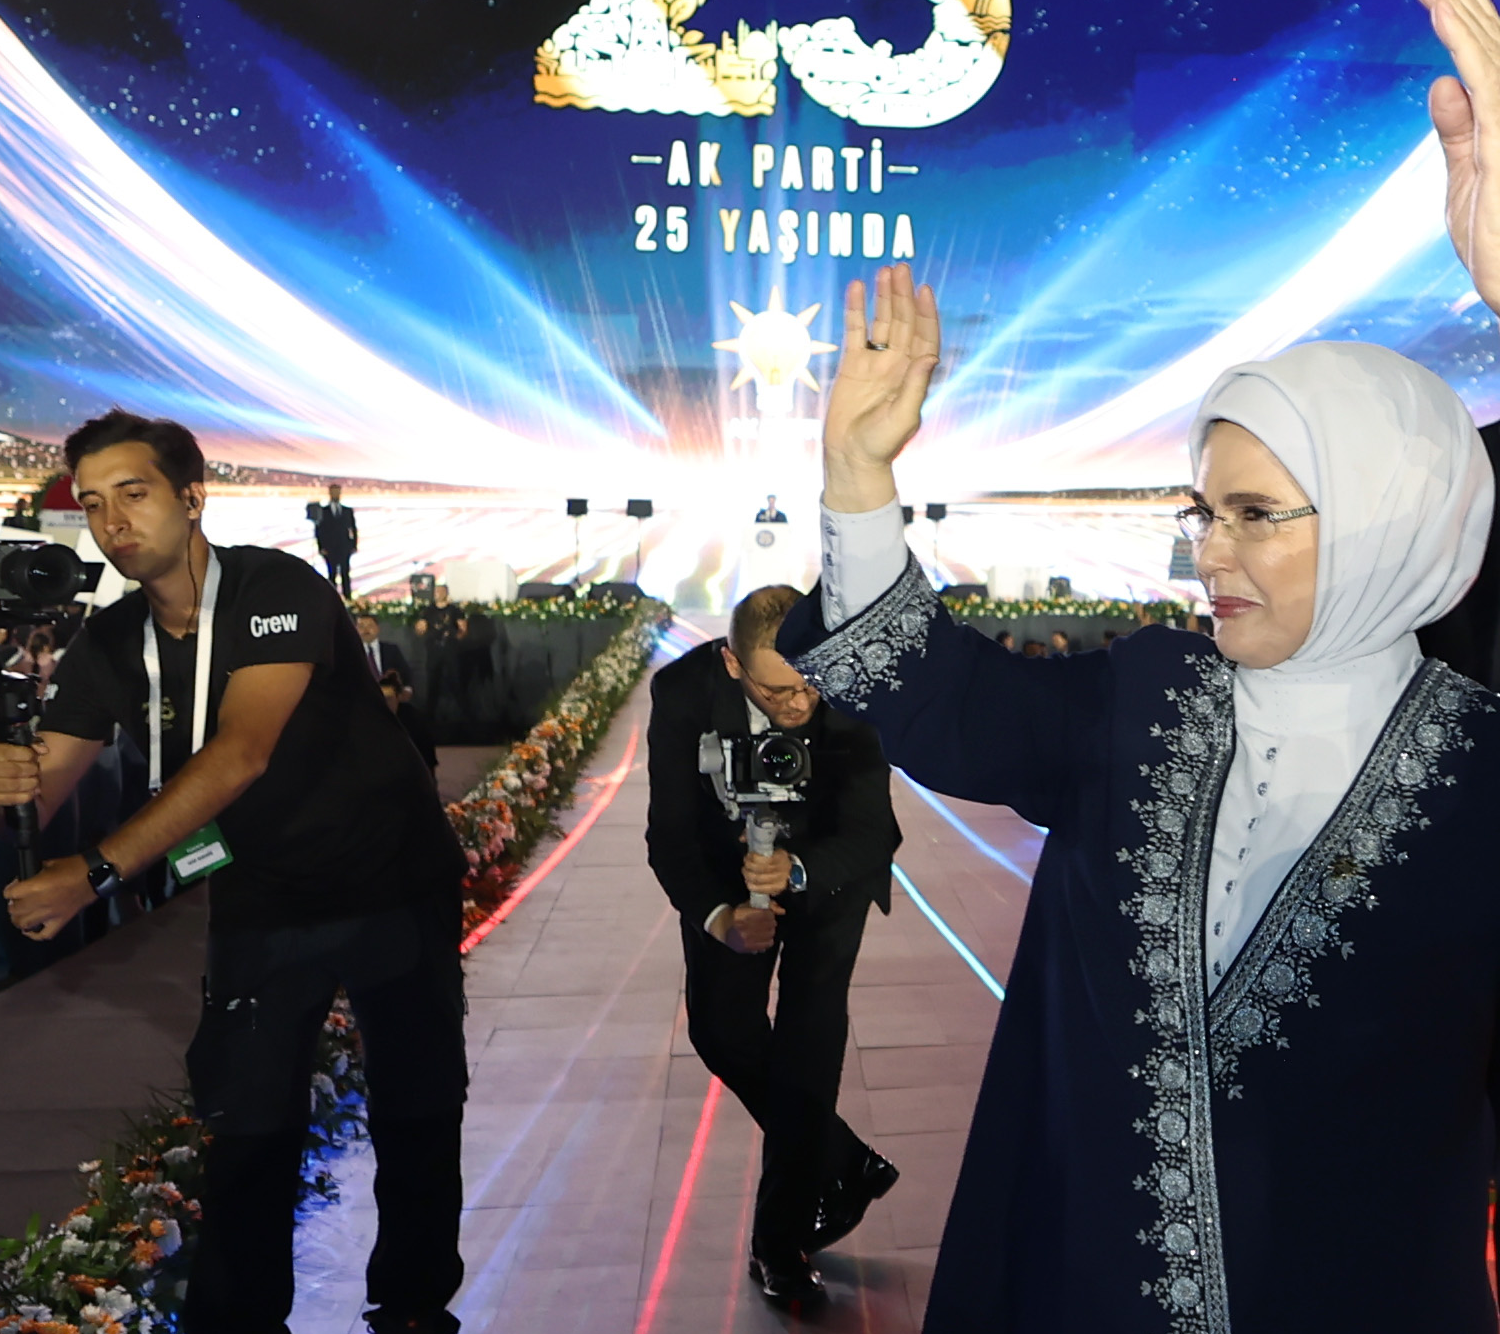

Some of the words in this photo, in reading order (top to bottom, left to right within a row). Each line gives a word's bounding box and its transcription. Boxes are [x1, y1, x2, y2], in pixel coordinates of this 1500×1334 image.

[666, 139, 722, 187] AK
[752, 137, 883, 194] PARTİ
[634, 204, 689, 253] 25
[718, 207, 915, 264] YAŞINDA
[250, 613, 298, 638] Crew
